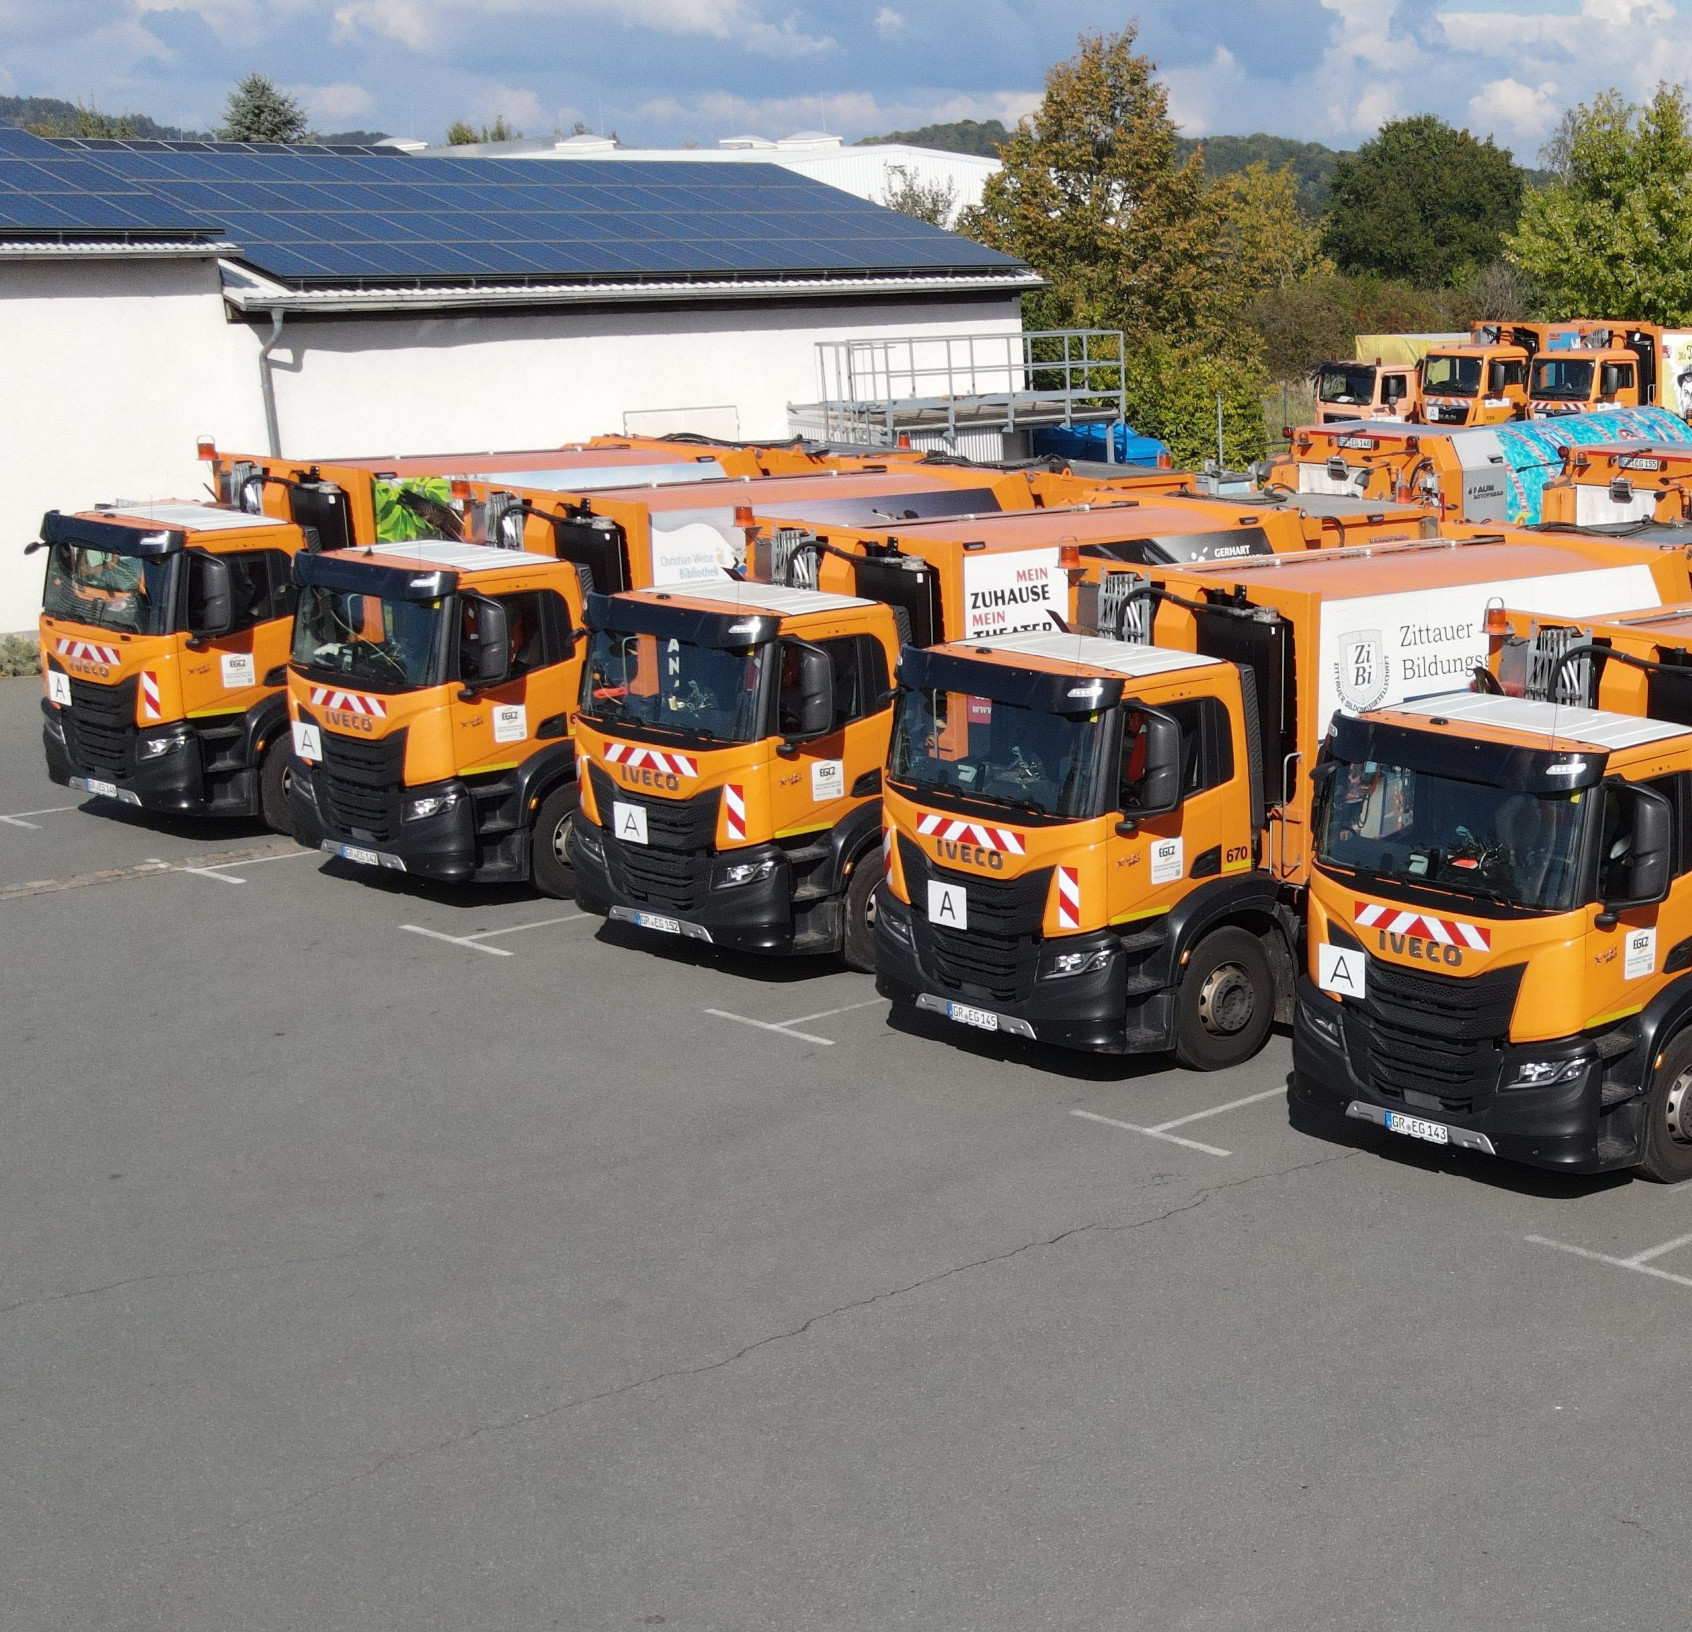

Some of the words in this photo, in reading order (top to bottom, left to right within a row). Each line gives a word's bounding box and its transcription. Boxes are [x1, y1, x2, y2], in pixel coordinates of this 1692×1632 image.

[660, 555, 693, 567] Christian
[694, 553, 715, 564] Weise
[1214, 545, 1251, 558] GERHART
[679, 567, 720, 580] Bibliothek
[1016, 567, 1049, 583] MEIN
[970, 584, 1051, 610] ZUHAUSE
[972, 611, 1006, 627] MEIN
[1400, 623, 1473, 648] Zittauer
[1355, 644, 1371, 665] Zi
[69, 657, 110, 678] IVECO
[1353, 665, 1372, 686] Bi
[55, 681, 66, 700] A
[325, 709, 373, 732] IVECO
[301, 729, 316, 754] A
[621, 765, 679, 791] IVECO
[623, 810, 640, 837] A
[937, 838, 1004, 871] IVECO
[1226, 846, 1248, 863] 670
[939, 890, 956, 920] A
[665, 919, 678, 932] 152
[1379, 930, 1463, 967] IVECO
[1330, 955, 1354, 989] A
[953, 1006, 964, 1018] GR
[968, 1010, 979, 1022] EG
[980, 1013, 996, 1027] 145
[1392, 1115, 1405, 1130] GR
[1412, 1120, 1426, 1134] EG
[1427, 1124, 1447, 1140] 143
